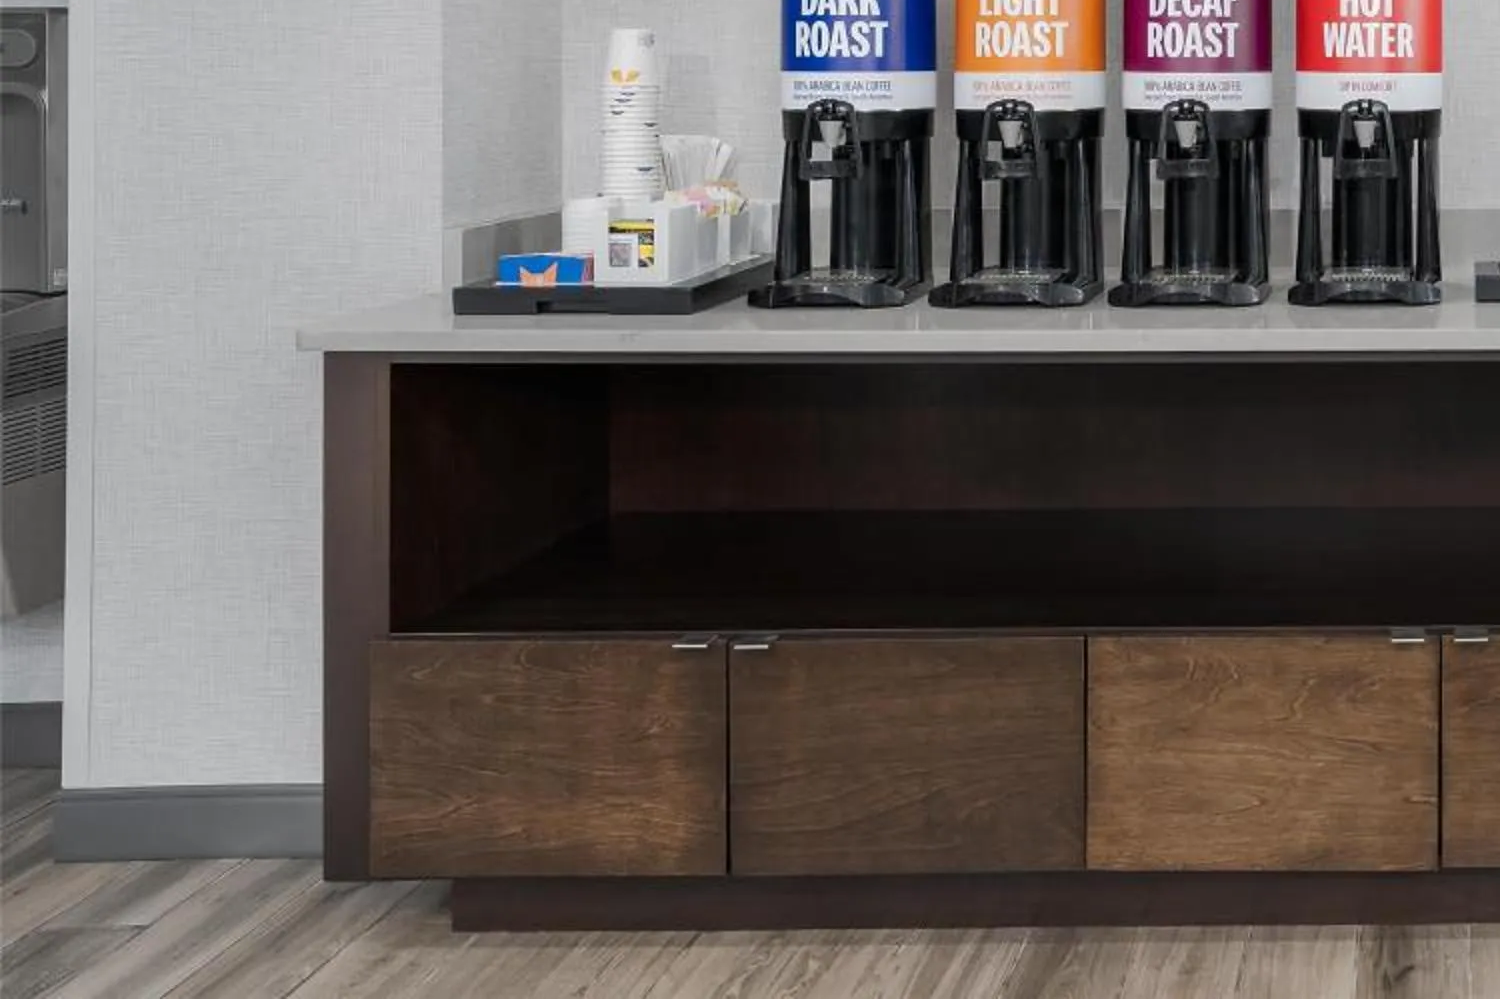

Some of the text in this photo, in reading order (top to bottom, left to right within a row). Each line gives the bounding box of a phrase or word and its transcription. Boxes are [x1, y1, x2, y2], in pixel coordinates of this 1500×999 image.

[795, 20, 889, 58] ROAST
[974, 21, 1070, 58] ROAST
[1146, 21, 1240, 58] ROAST
[1322, 21, 1414, 58] WATER
